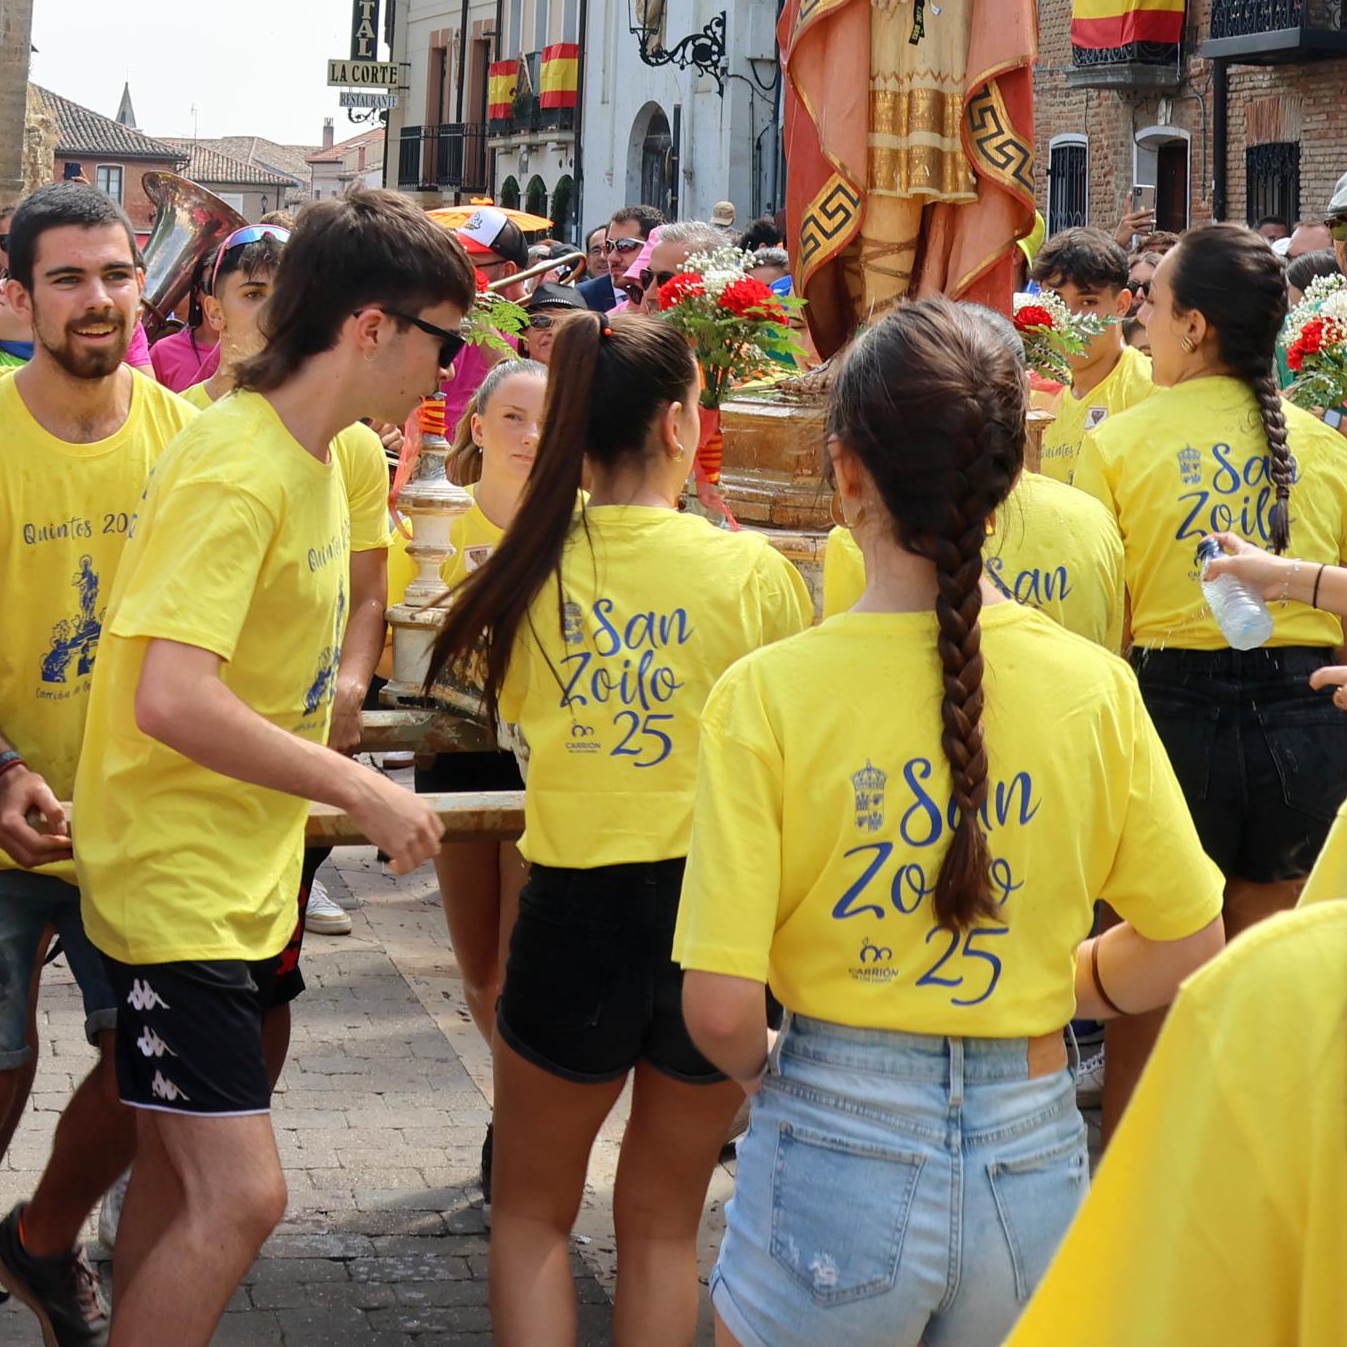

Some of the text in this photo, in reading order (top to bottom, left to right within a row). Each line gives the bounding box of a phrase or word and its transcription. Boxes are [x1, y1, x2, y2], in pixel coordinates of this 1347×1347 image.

[330, 63, 398, 85] LA CORTE
[340, 91, 398, 108] RESTAURANTE
[23, 517, 92, 545] Quintos
[592, 598, 694, 657] San
[559, 649, 685, 712] Zoilo
[609, 710, 675, 768] 25
[915, 925, 1010, 1006] 25
